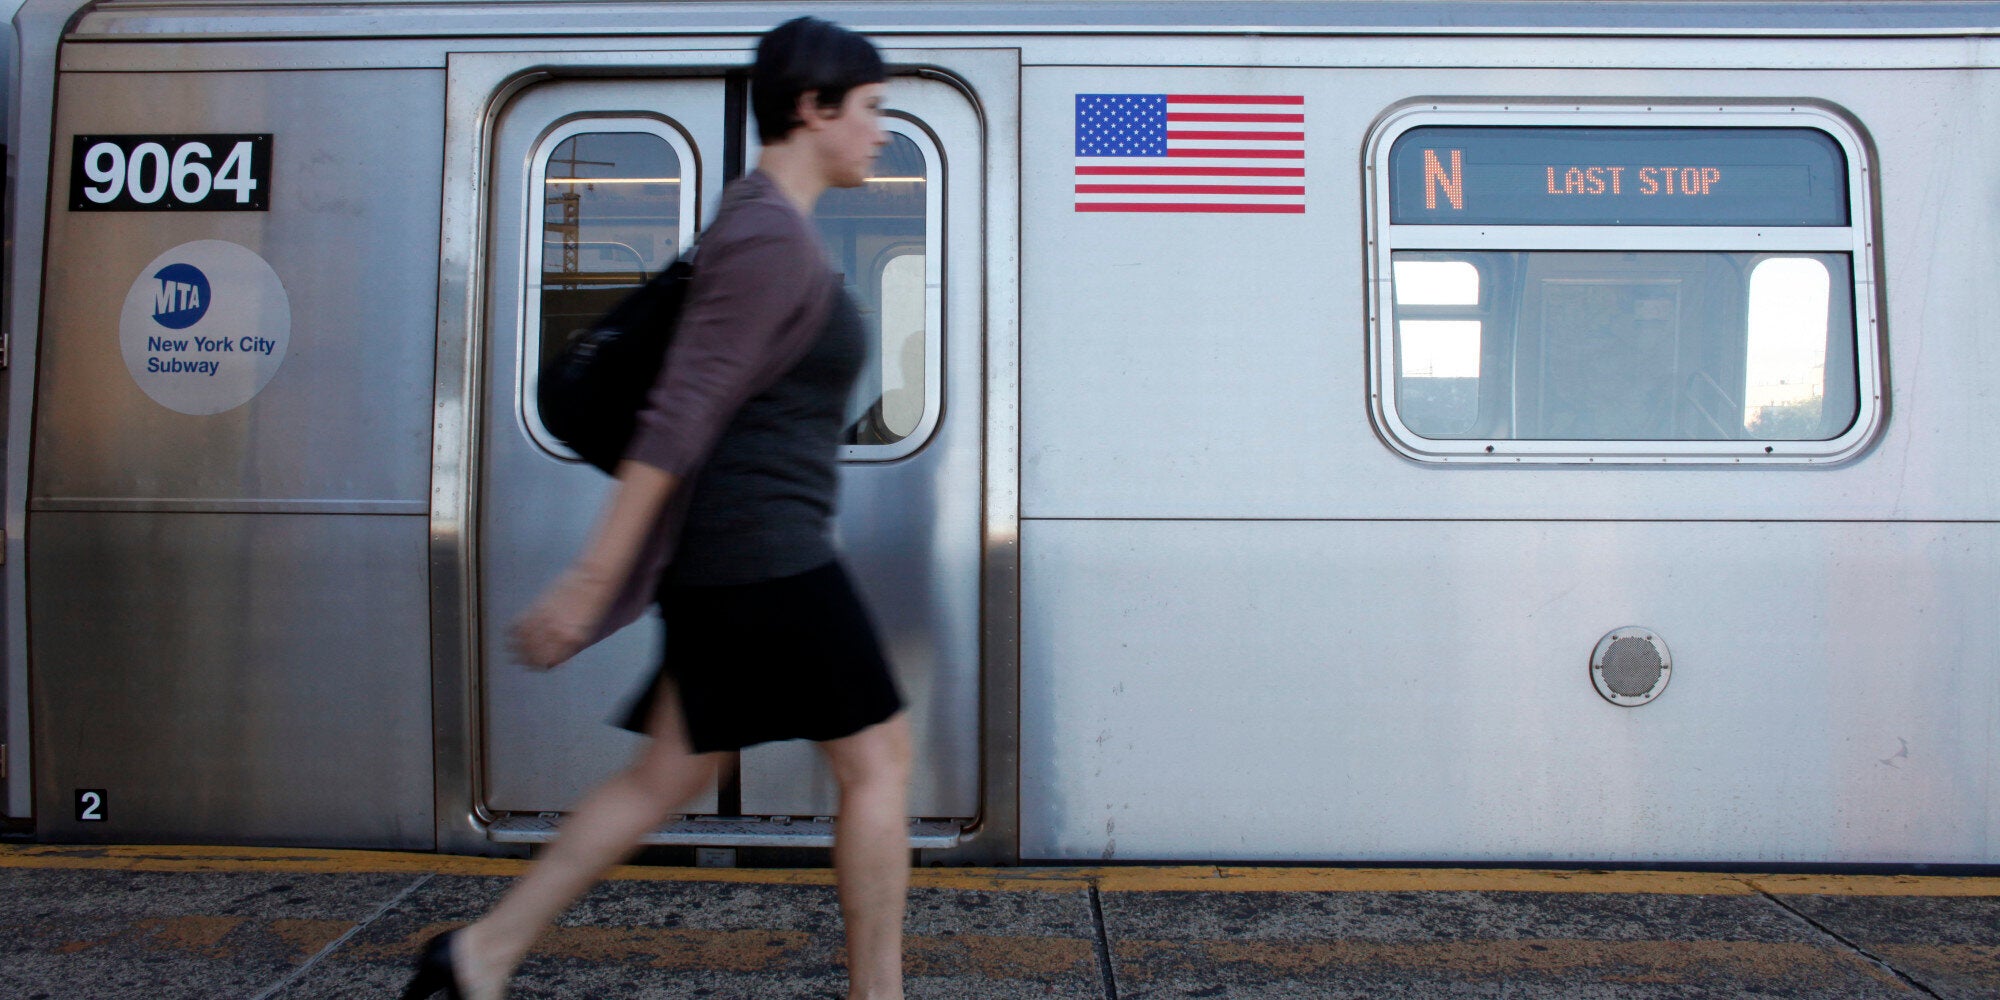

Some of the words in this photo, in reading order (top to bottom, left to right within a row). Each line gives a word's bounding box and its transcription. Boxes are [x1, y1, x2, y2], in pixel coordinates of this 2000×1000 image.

[84, 141, 257, 204] 9064
[1424, 149, 1463, 209] N
[1547, 166, 1625, 195] LAST
[1639, 167, 1721, 195] STOP
[153, 278, 200, 315] MTA
[148, 336, 188, 352] New
[194, 336, 234, 352] York
[239, 336, 276, 356] City
[147, 357, 219, 376] Subway
[81, 791, 102, 820] 2
